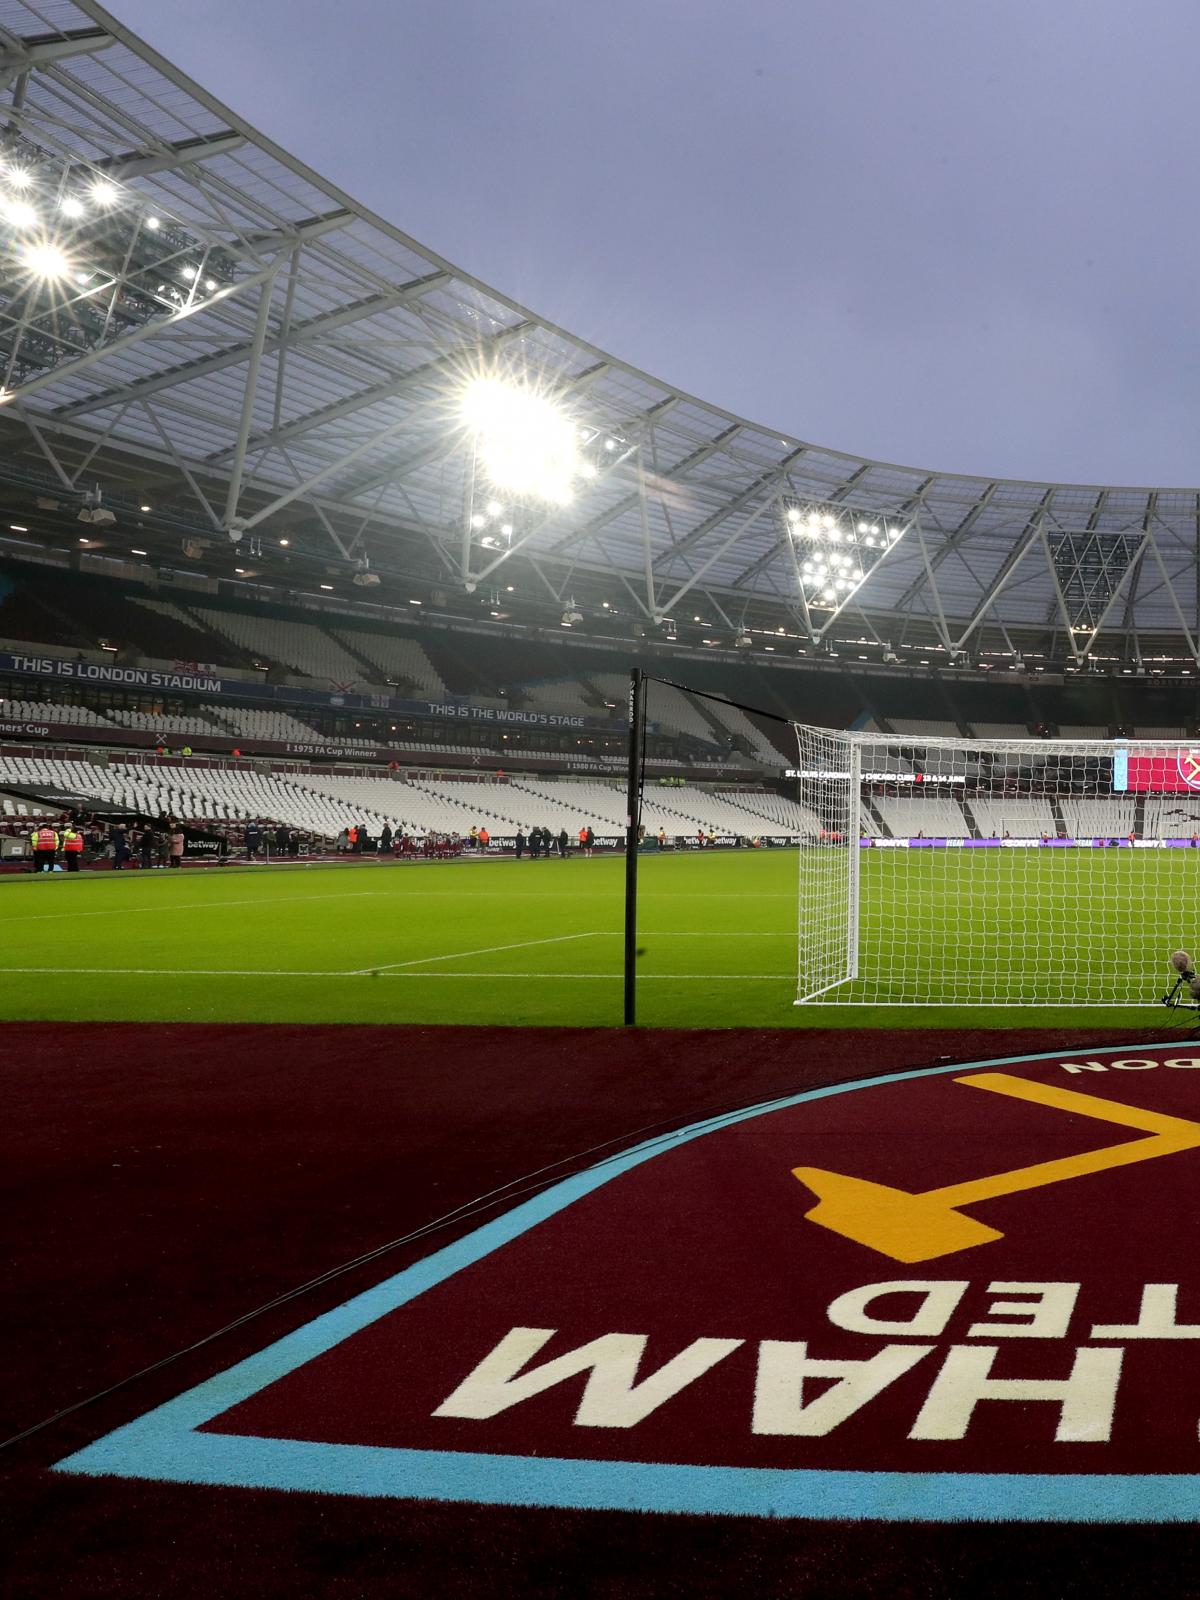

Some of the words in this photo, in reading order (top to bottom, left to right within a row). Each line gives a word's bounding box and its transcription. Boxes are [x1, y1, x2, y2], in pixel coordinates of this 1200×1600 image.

[11, 655, 53, 673] THIS
[57, 661, 73, 676] IS
[77, 664, 148, 685] LONDON
[151, 673, 222, 692] STADIUM
[428, 703, 455, 716] THIS
[458, 706, 469, 717] IS
[471, 708, 494, 720] THE
[496, 710, 547, 724] WORLD'S
[549, 715, 585, 727] STAGE
[27, 724, 49, 735] Cup
[293, 744, 313, 753] 1975
[315, 746, 325, 754] FA
[327, 747, 343, 757] Cup
[345, 748, 377, 757] Winners
[785, 769, 797, 778] ST.
[797, 770, 818, 778] LOUIS
[947, 775, 965, 783] JUNE
[187, 839, 220, 850] betway
[430, 1326, 1126, 1442] HAM
